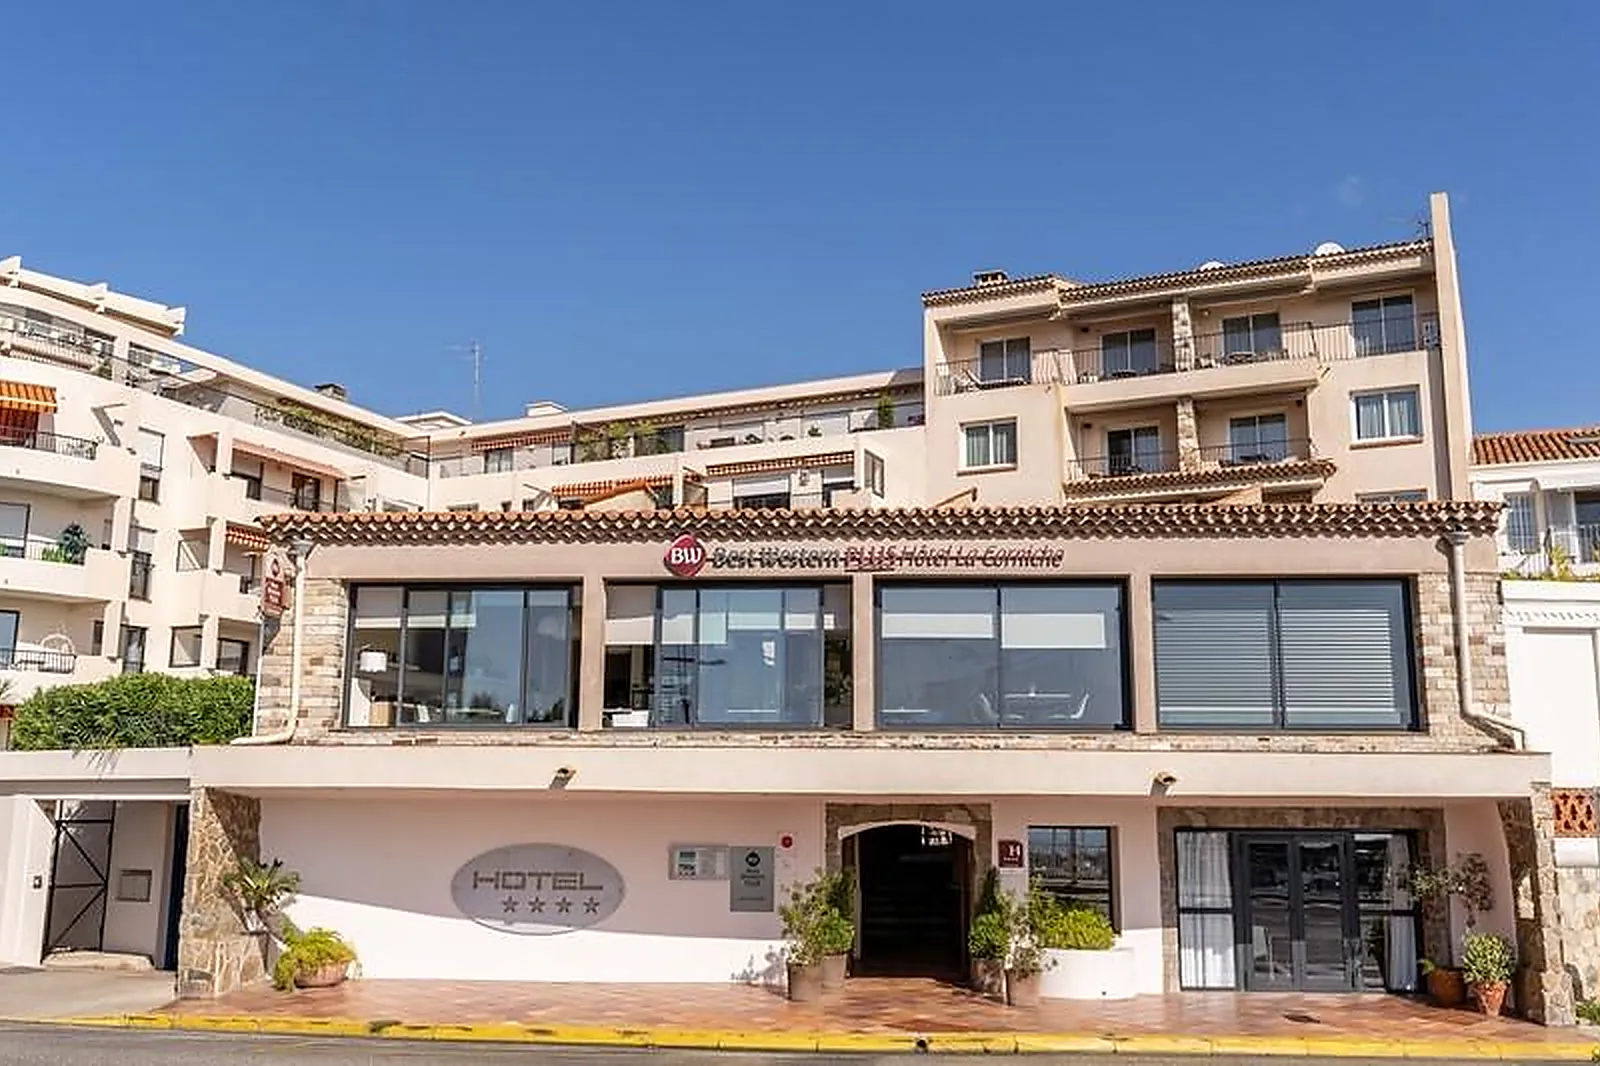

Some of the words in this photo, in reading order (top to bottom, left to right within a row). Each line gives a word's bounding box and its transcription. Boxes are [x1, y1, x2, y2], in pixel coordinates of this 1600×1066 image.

[671, 547, 702, 565] BW
[712, 546, 757, 569] Best
[759, 546, 841, 569] Western
[954, 546, 978, 567] La
[982, 545, 1064, 567] Corniche
[473, 871, 603, 891] HOTEL
